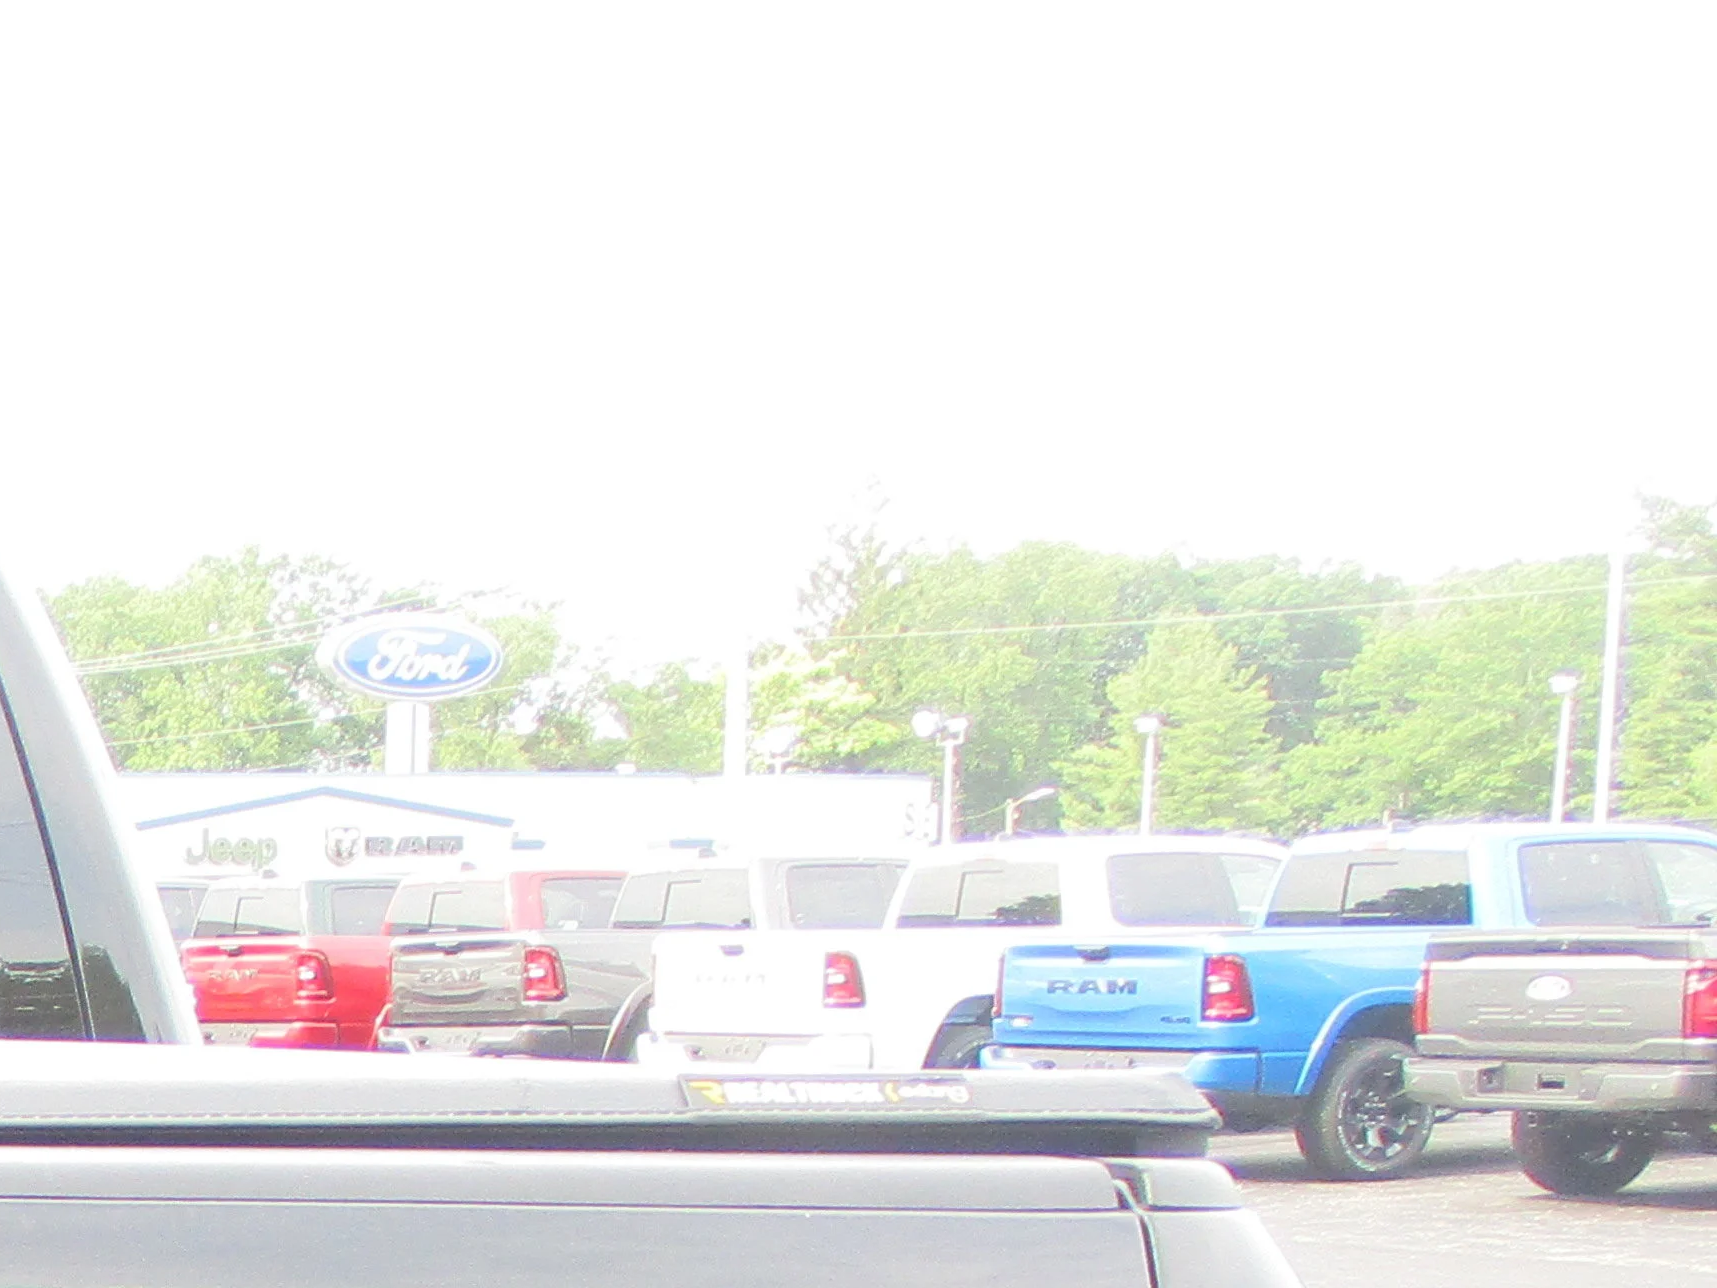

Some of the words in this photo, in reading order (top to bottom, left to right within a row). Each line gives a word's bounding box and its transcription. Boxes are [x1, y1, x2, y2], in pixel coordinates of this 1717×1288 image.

[367, 629, 471, 681] Ford
[183, 827, 278, 872] Jeep
[364, 835, 465, 857] RAM
[1046, 978, 1138, 996] RAM
